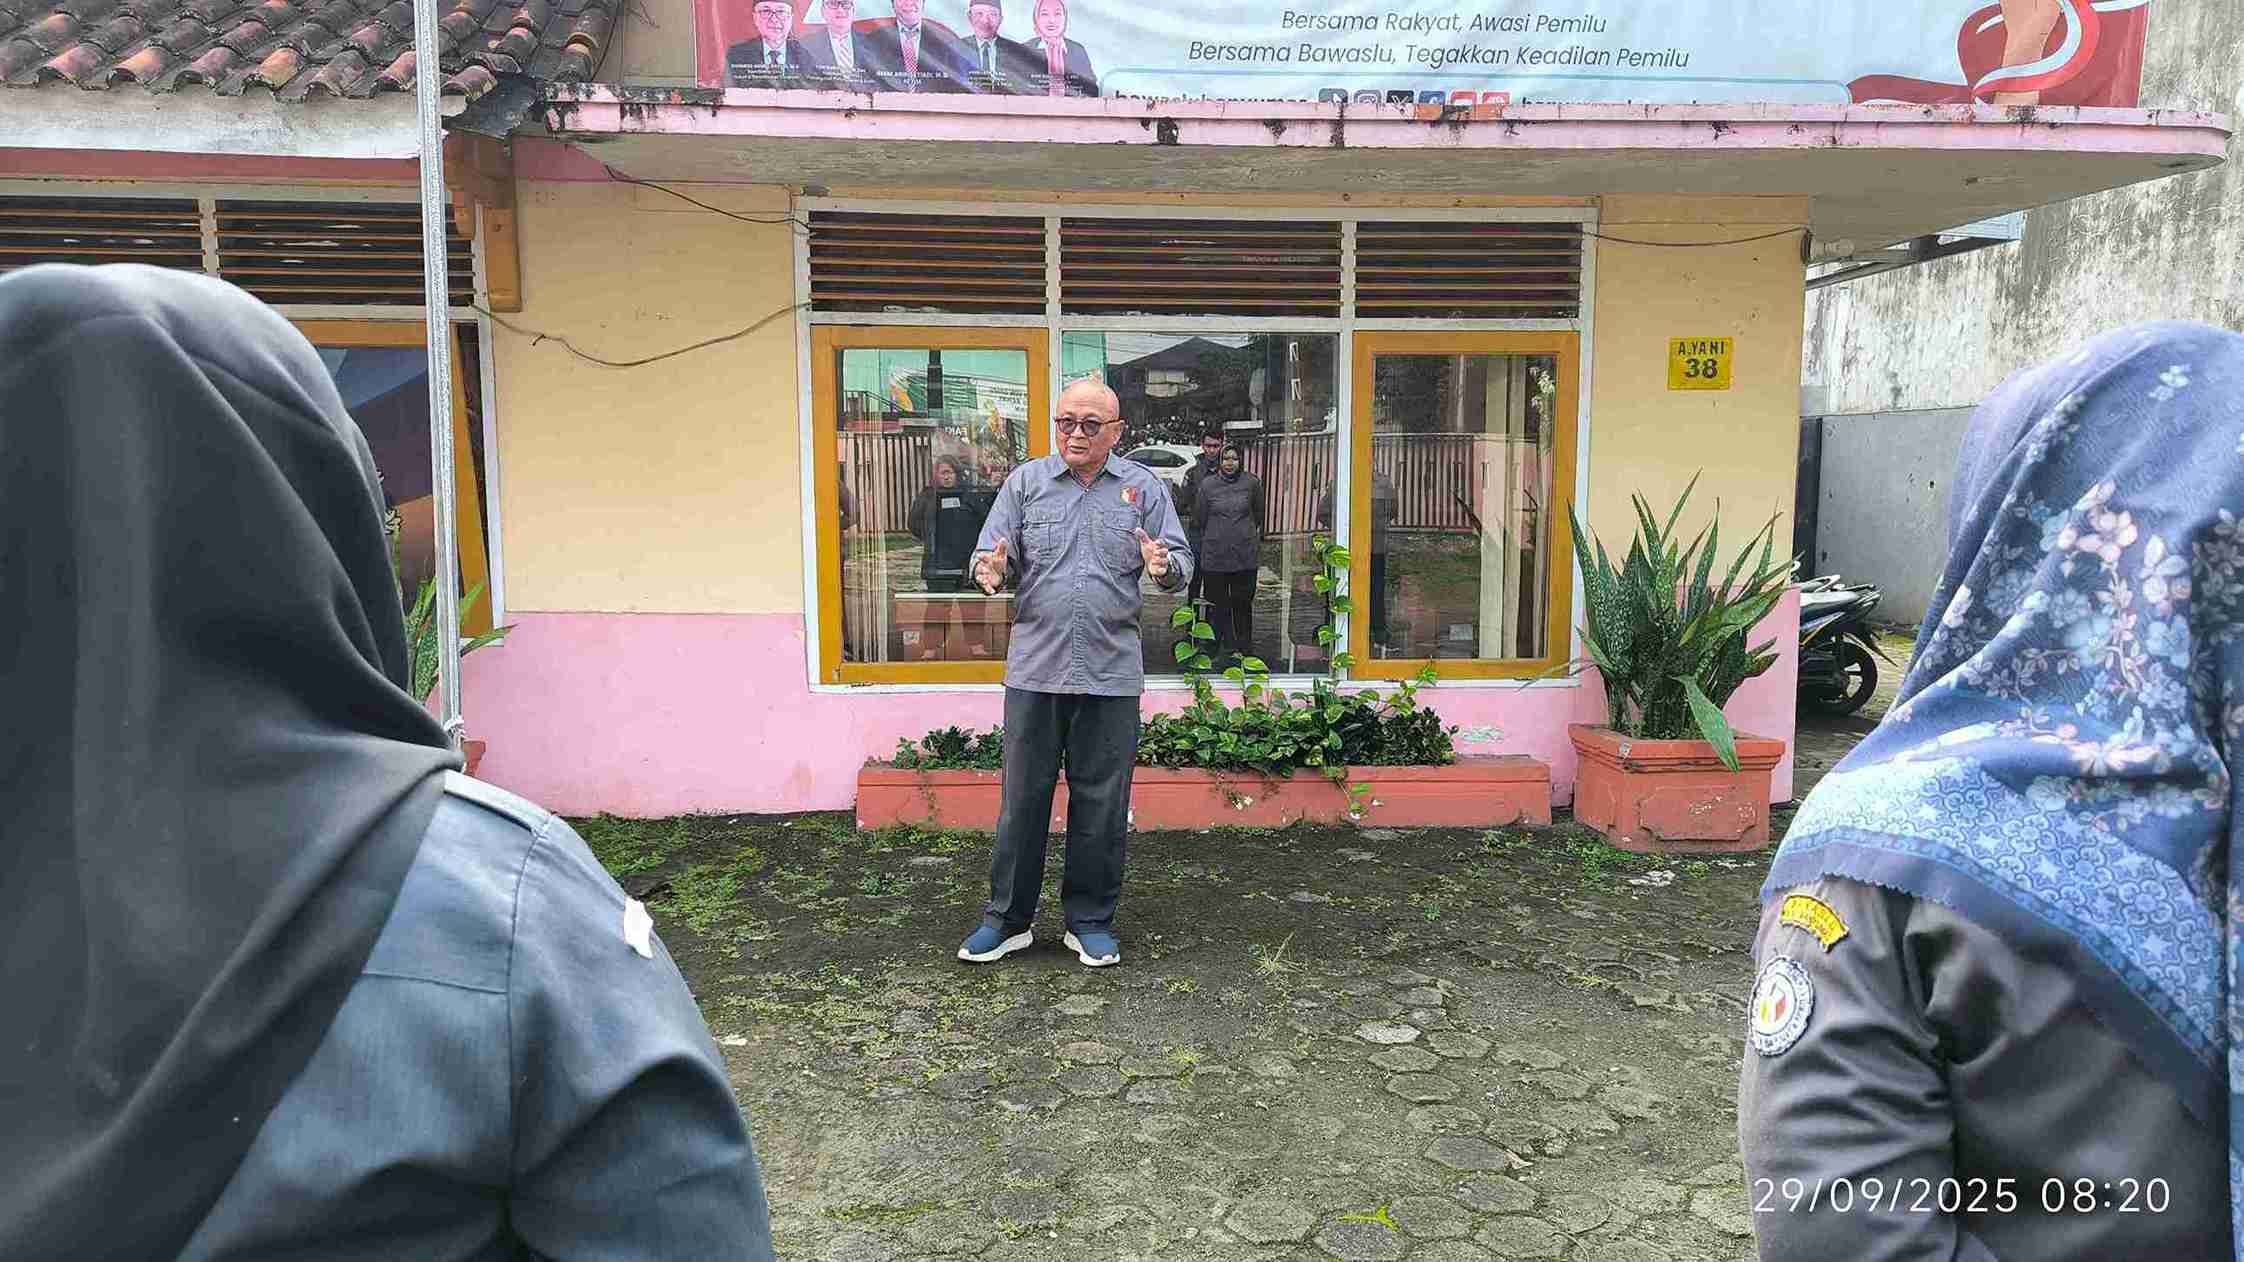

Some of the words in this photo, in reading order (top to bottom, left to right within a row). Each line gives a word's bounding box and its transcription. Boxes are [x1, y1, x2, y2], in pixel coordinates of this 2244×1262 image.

[1281, 10, 1379, 30] Bersama
[1385, 12, 1463, 36] Rakyat,
[1470, 14, 1531, 33] Awasi
[1535, 14, 1607, 33] Pemilu
[1188, 41, 1291, 61] Bersama
[1297, 43, 1396, 65] Bawaslu,
[1406, 44, 1510, 70] Tegakkan
[1516, 46, 1610, 66] Keadilan
[1615, 48, 1689, 68] Pemilu
[1685, 358, 1718, 379] 38
